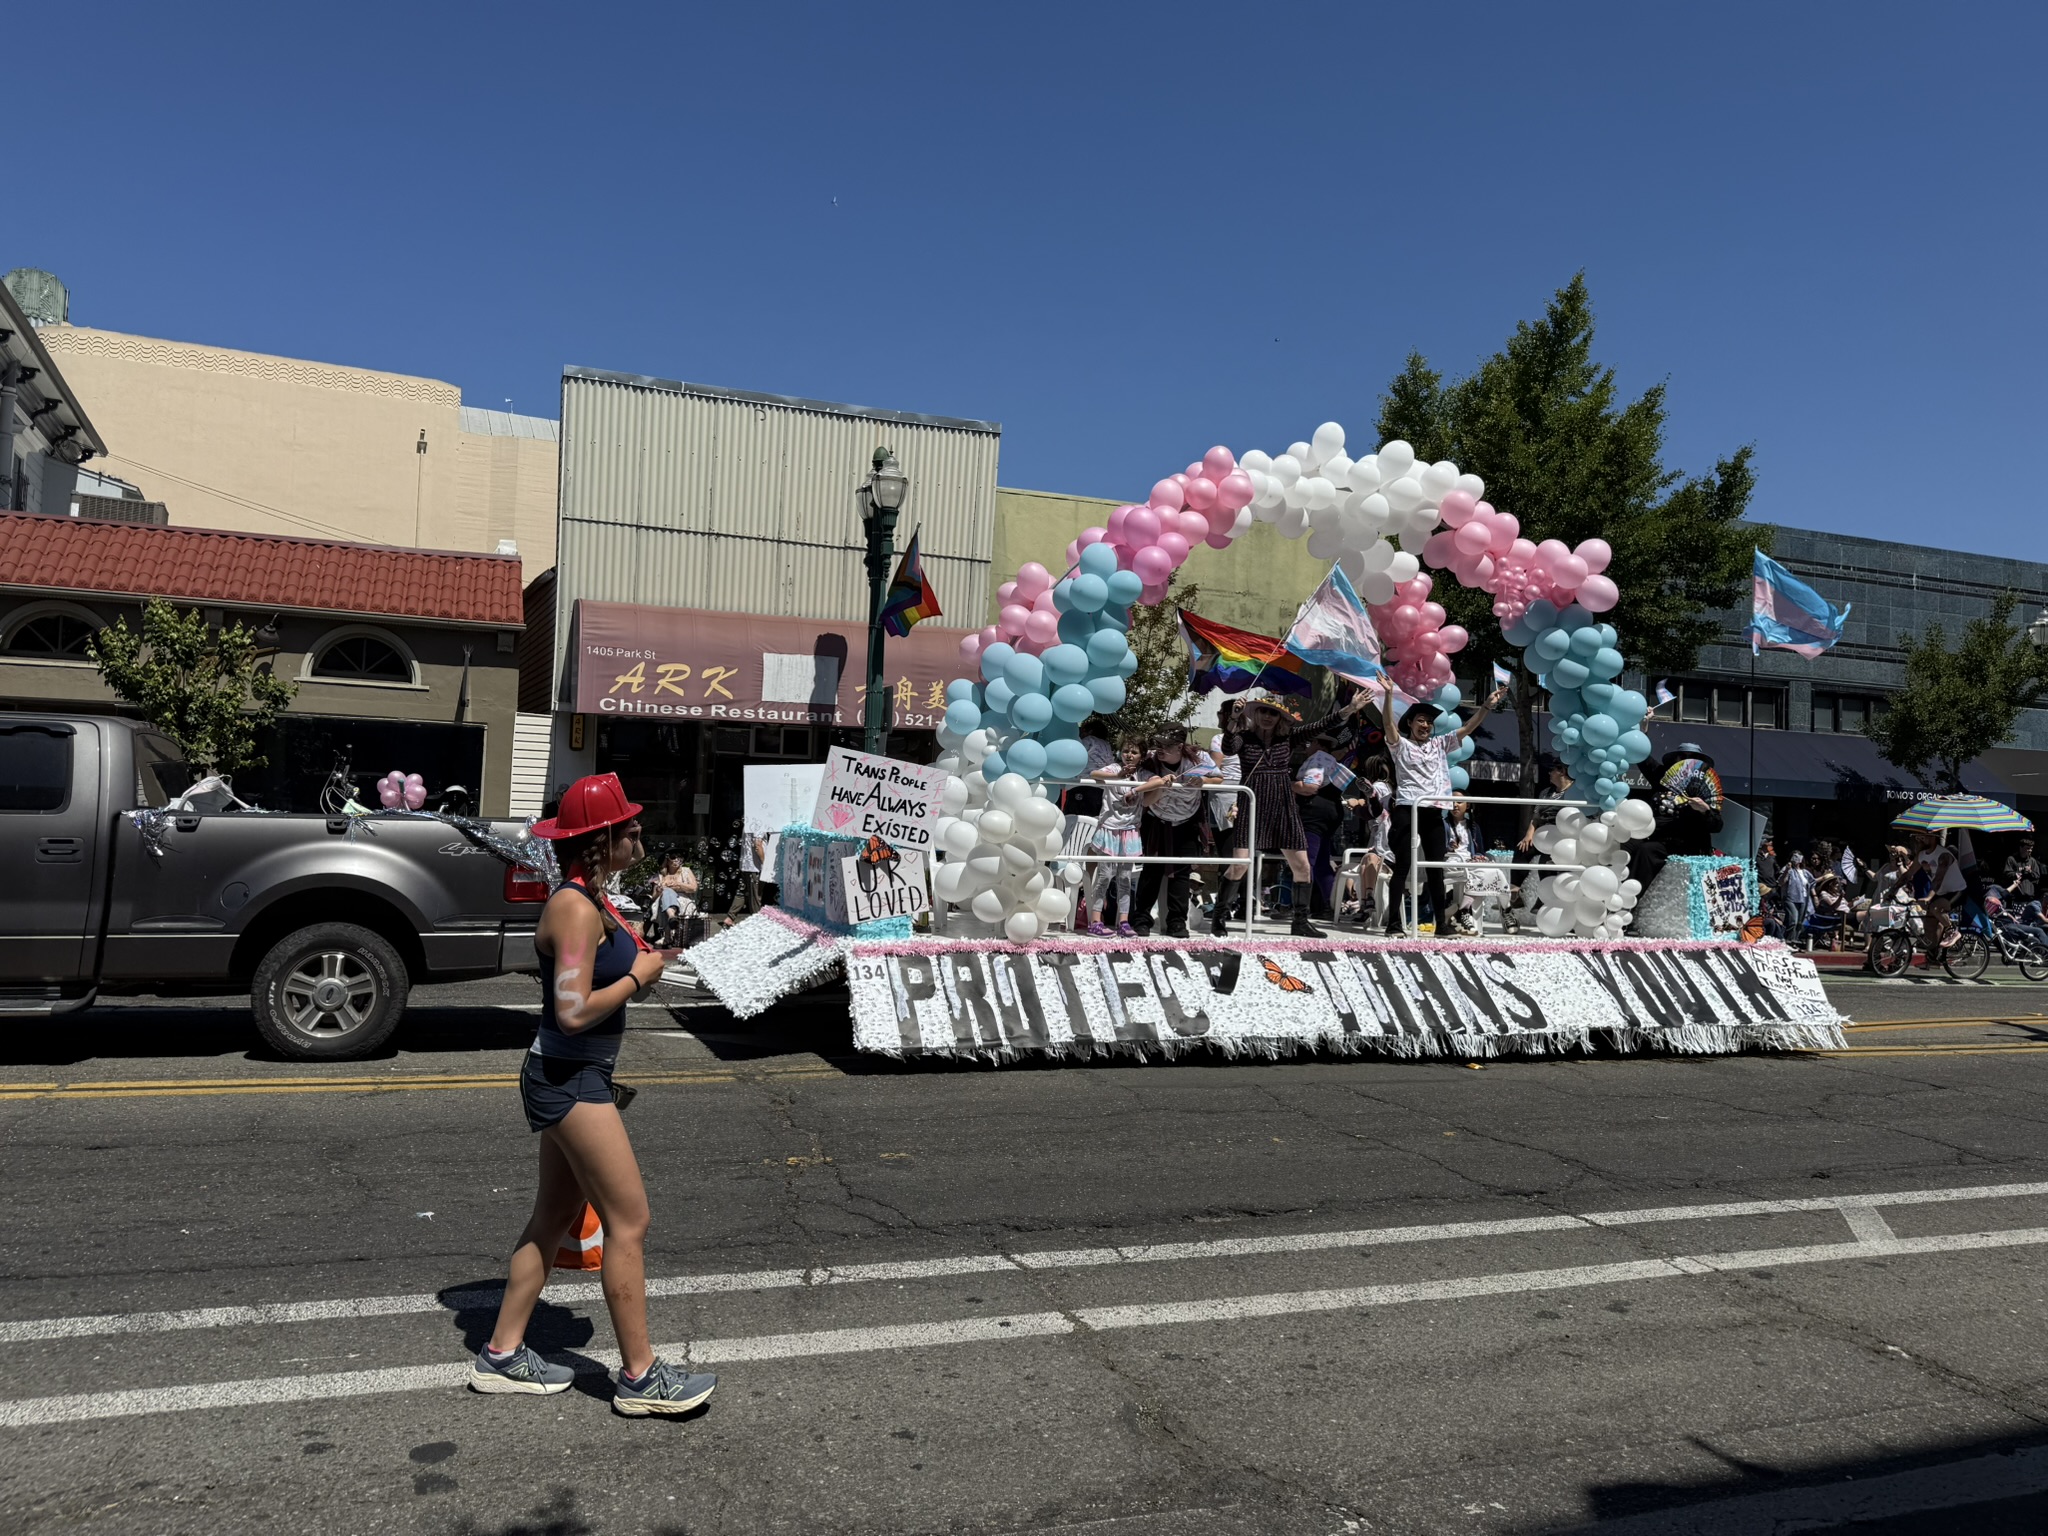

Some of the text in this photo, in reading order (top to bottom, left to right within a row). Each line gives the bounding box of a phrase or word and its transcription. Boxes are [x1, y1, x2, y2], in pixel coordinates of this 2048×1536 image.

[586, 645, 656, 660] 1405 Park St
[608, 661, 739, 700] ARK
[599, 697, 703, 716] Chinese
[711, 704, 842, 723] Restaurant
[905, 713, 946, 727] 521-
[842, 755, 928, 791] TRANS PEOPLE
[1687, 768, 1705, 780] ARE
[831, 782, 927, 818] HAVE ALWAYS
[1886, 790, 1940, 801] TOMO'S ORGA
[854, 886, 923, 922] LOVED
[853, 964, 885, 981] 134
[1301, 950, 1548, 1035] TRANS
[1572, 949, 1794, 1028] YOUTH
[1796, 1003, 1821, 1016] 134
